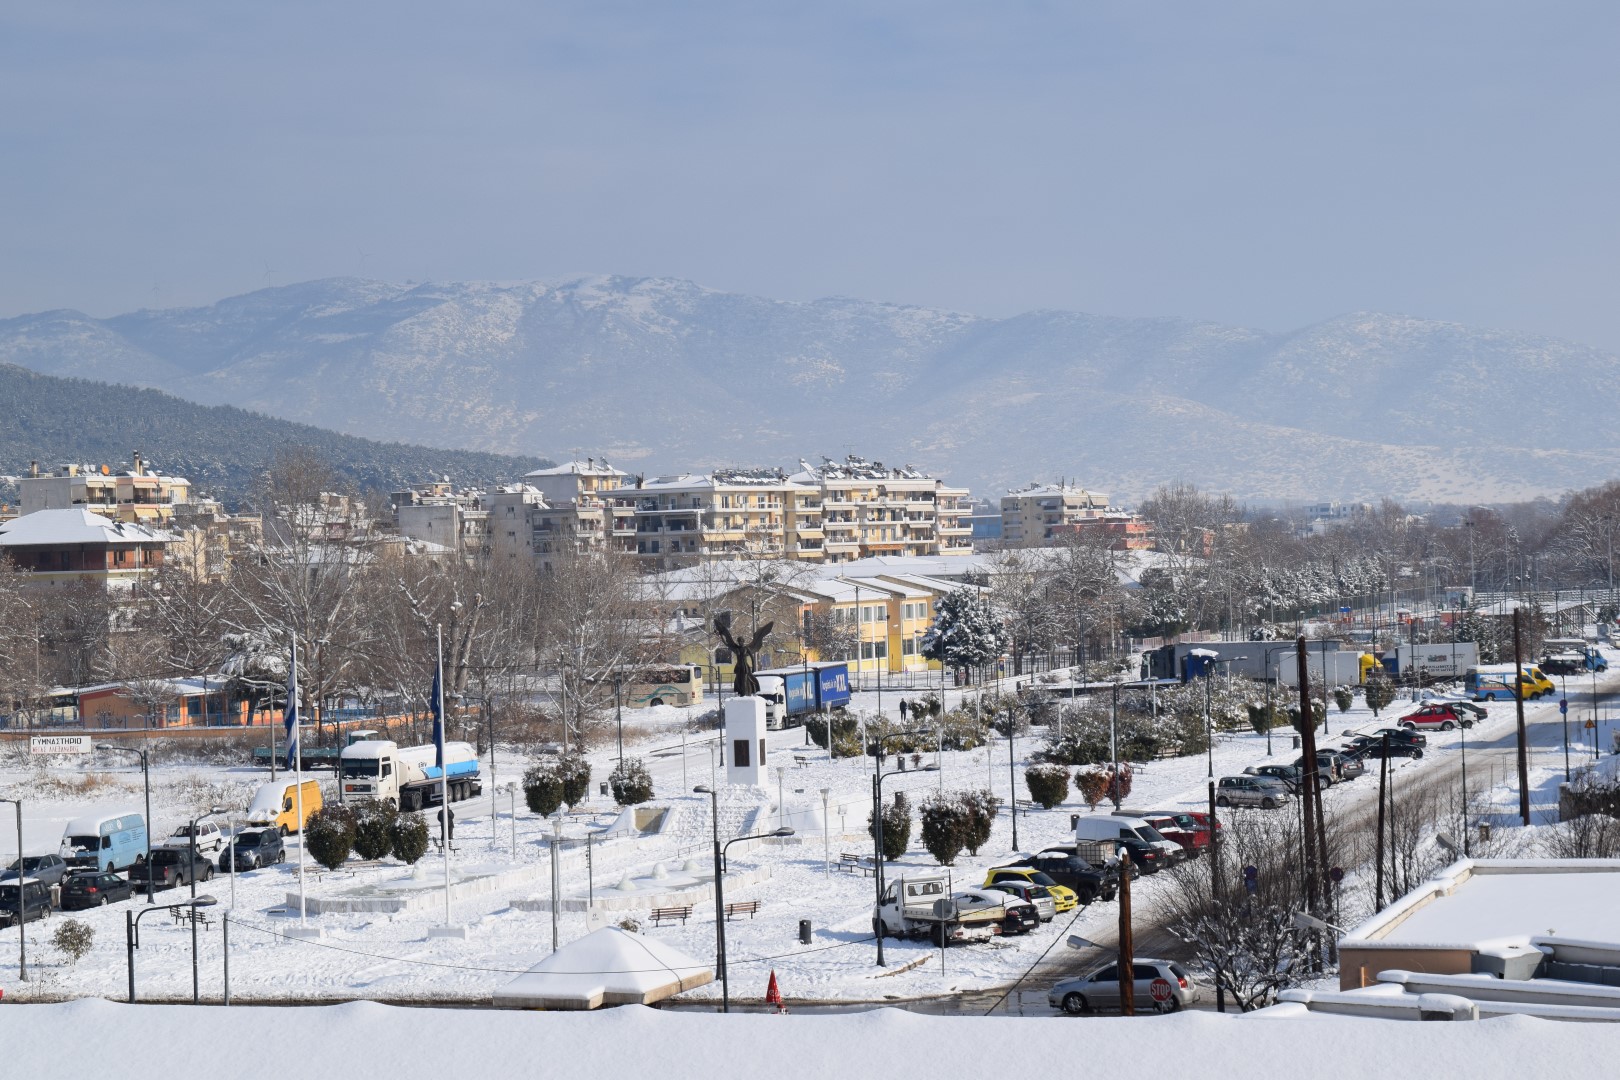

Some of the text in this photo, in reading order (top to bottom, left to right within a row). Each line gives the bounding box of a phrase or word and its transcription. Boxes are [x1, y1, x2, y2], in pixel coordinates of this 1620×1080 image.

[835, 674, 847, 692] XXL
[32, 737, 82, 745] ΓΥΜΝΑΣΤΗΡΙΟ
[1151, 983, 1170, 996] STOP
